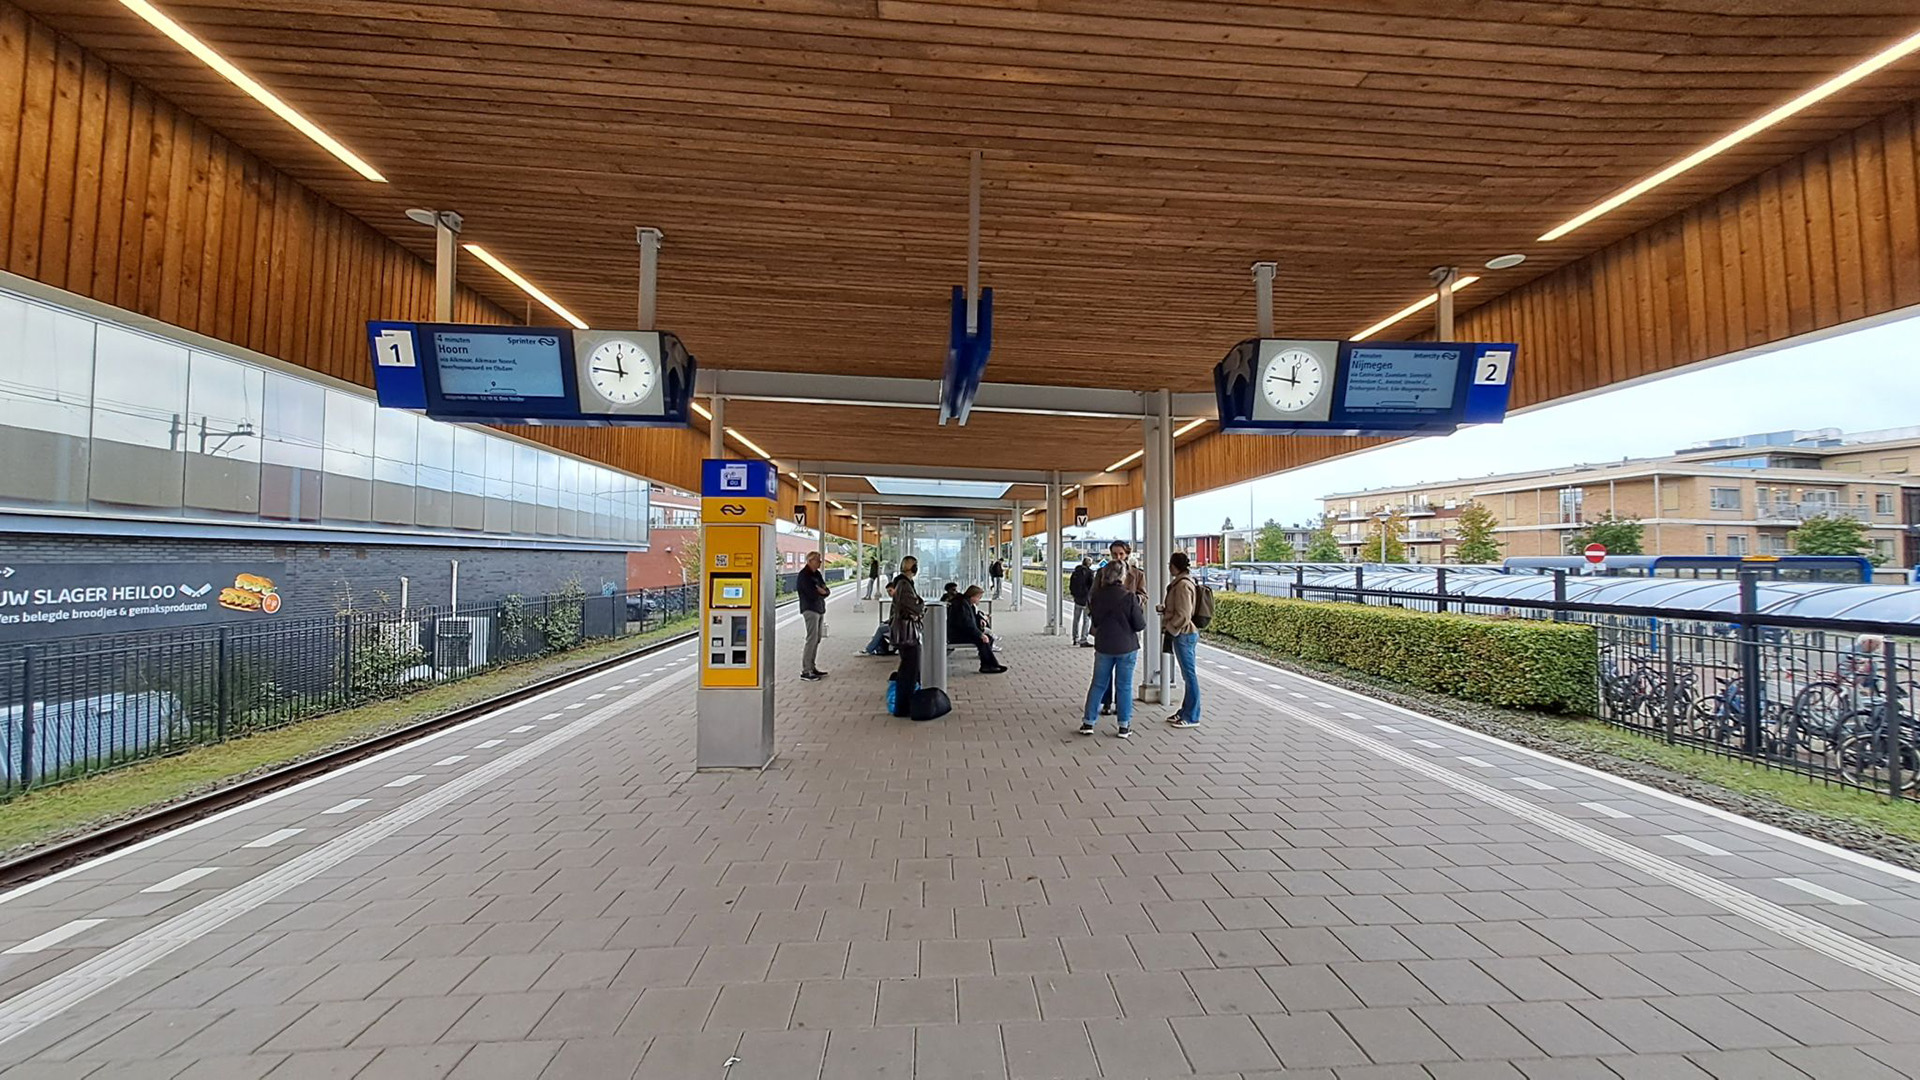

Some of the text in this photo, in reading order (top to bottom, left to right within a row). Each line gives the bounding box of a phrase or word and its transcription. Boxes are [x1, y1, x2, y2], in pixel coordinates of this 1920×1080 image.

[437, 334, 443, 342] 4
[507, 337, 537, 346] Sprinter
[389, 343, 401, 363] 1
[439, 344, 469, 354] Hoorn
[1353, 350, 1359, 359] 2
[1413, 352, 1440, 360] Intercity
[1351, 360, 1393, 372] Nijmegen
[1484, 363, 1498, 381] 2
[795, 514, 804, 525] V
[1078, 516, 1087, 527] V
[34, 586, 108, 605] SLAGER
[112, 584, 176, 601] HEILOO
[22, 609, 70, 623] belegde
[71, 607, 118, 619] broodjes
[119, 607, 127, 617] &
[128, 602, 208, 618] gemaksproducten
